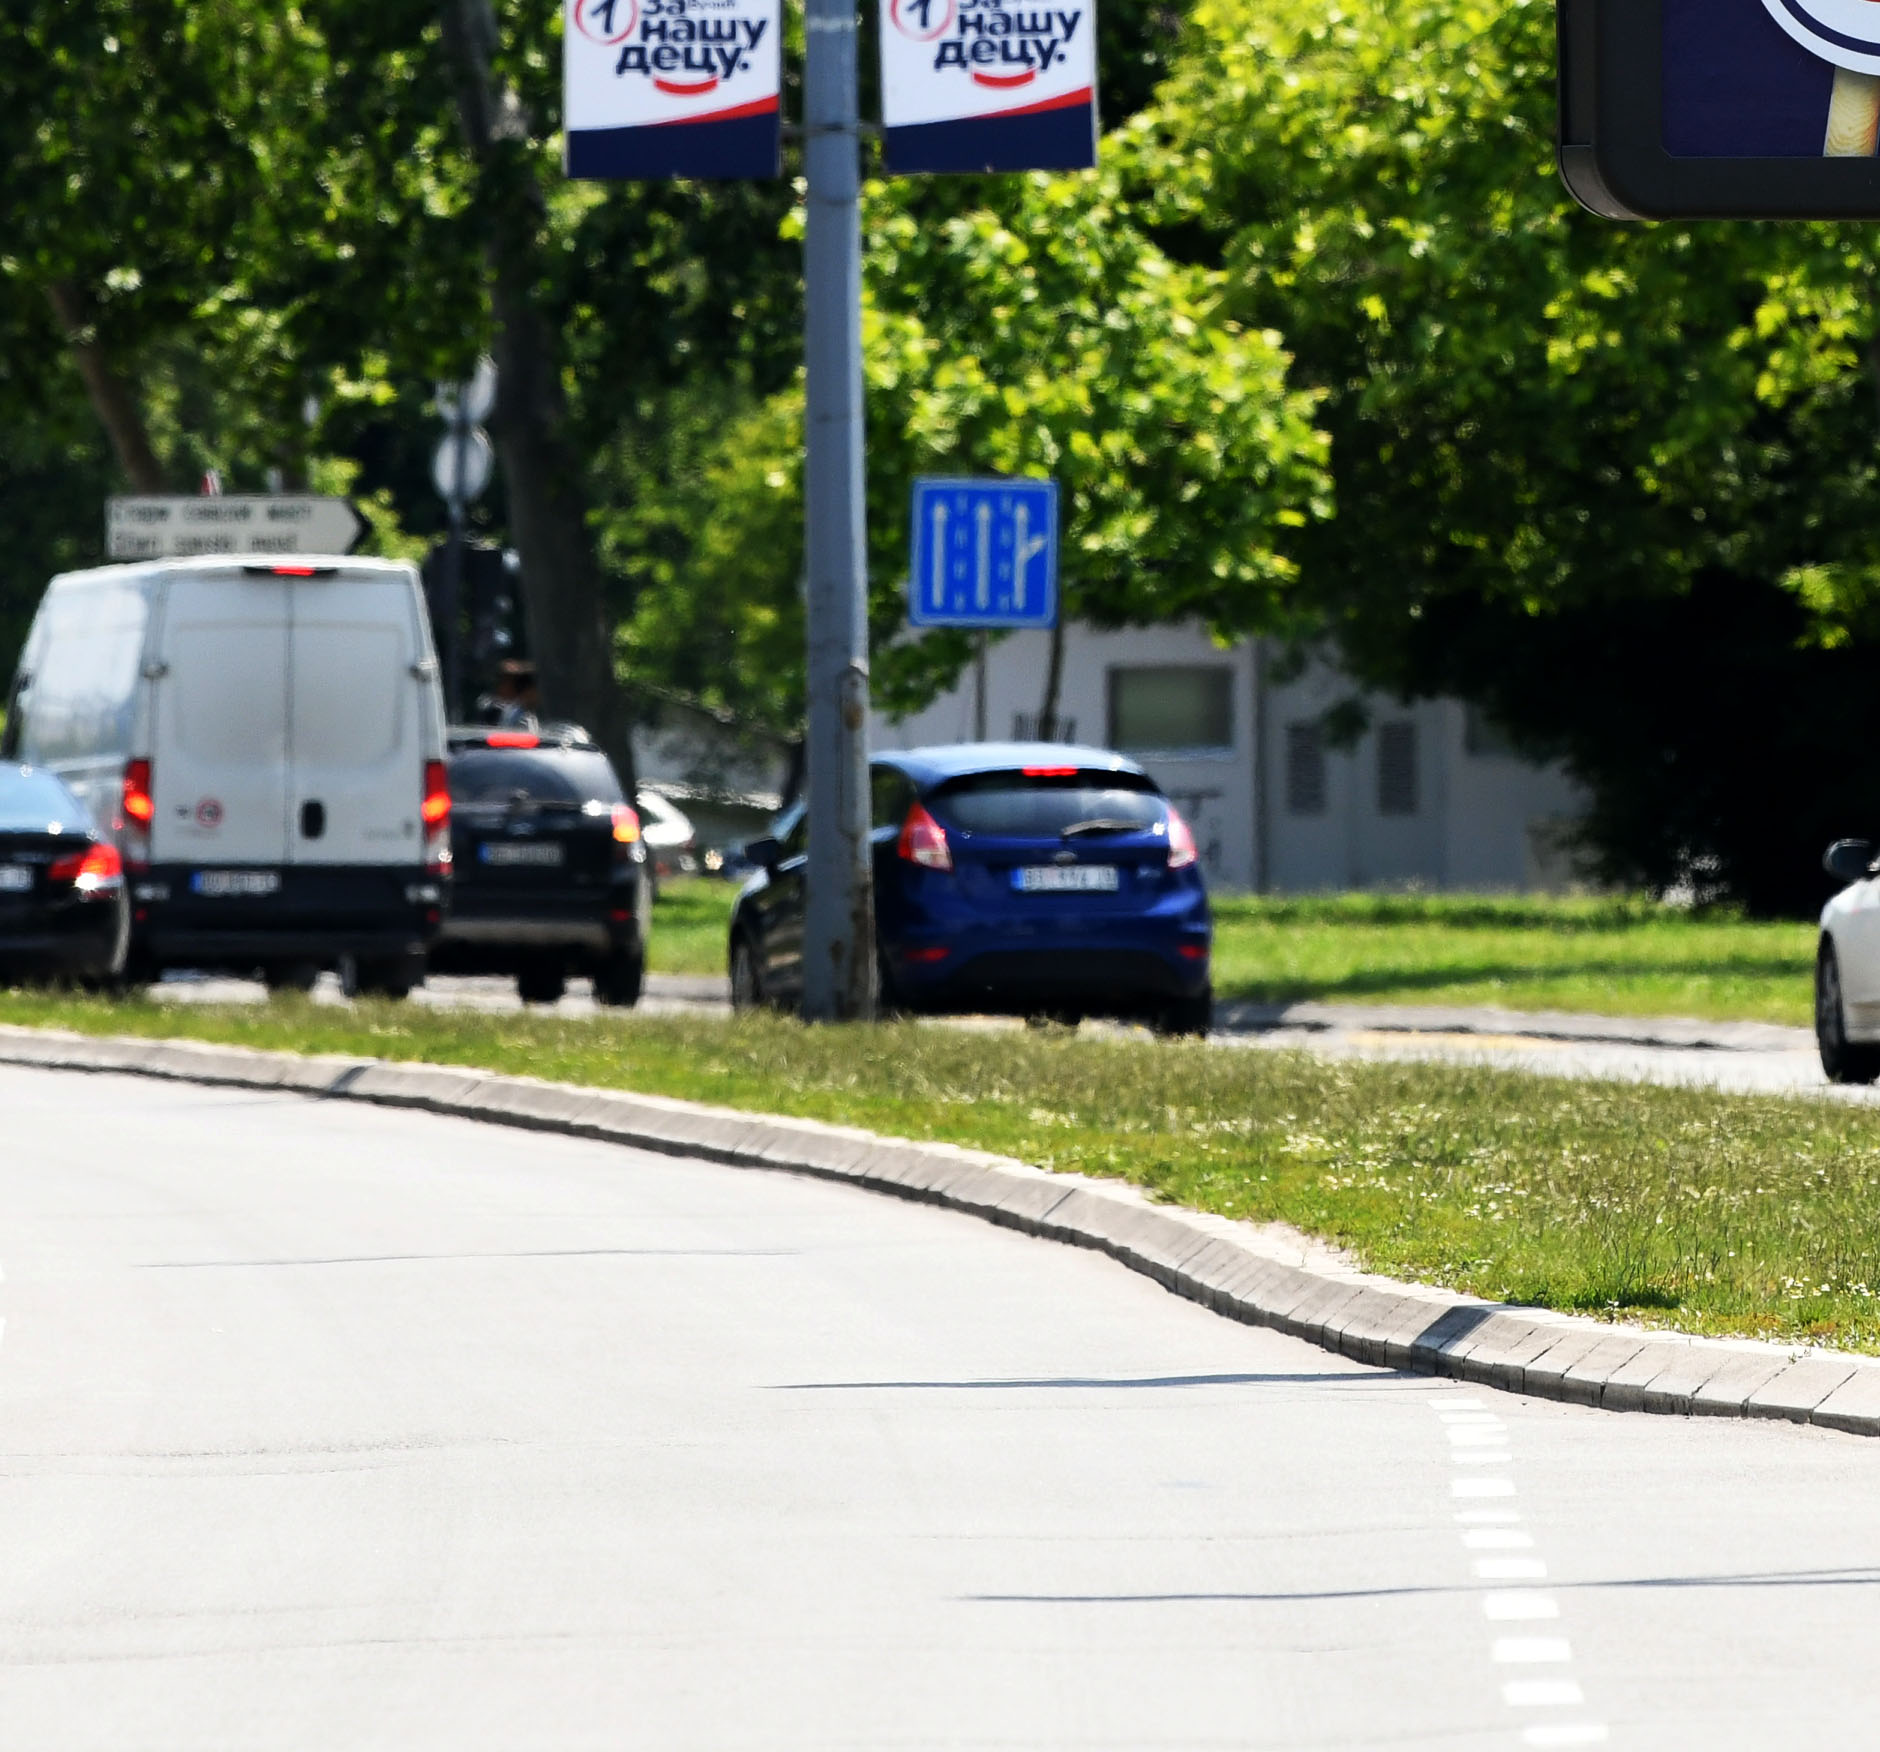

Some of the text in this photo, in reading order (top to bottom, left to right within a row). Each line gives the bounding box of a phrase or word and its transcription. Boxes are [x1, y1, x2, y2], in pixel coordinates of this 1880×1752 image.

[640, 19, 767, 49] нашу
[958, 11, 1081, 42] нашу
[615, 46, 751, 79] децу.
[933, 38, 1067, 70] децу.
